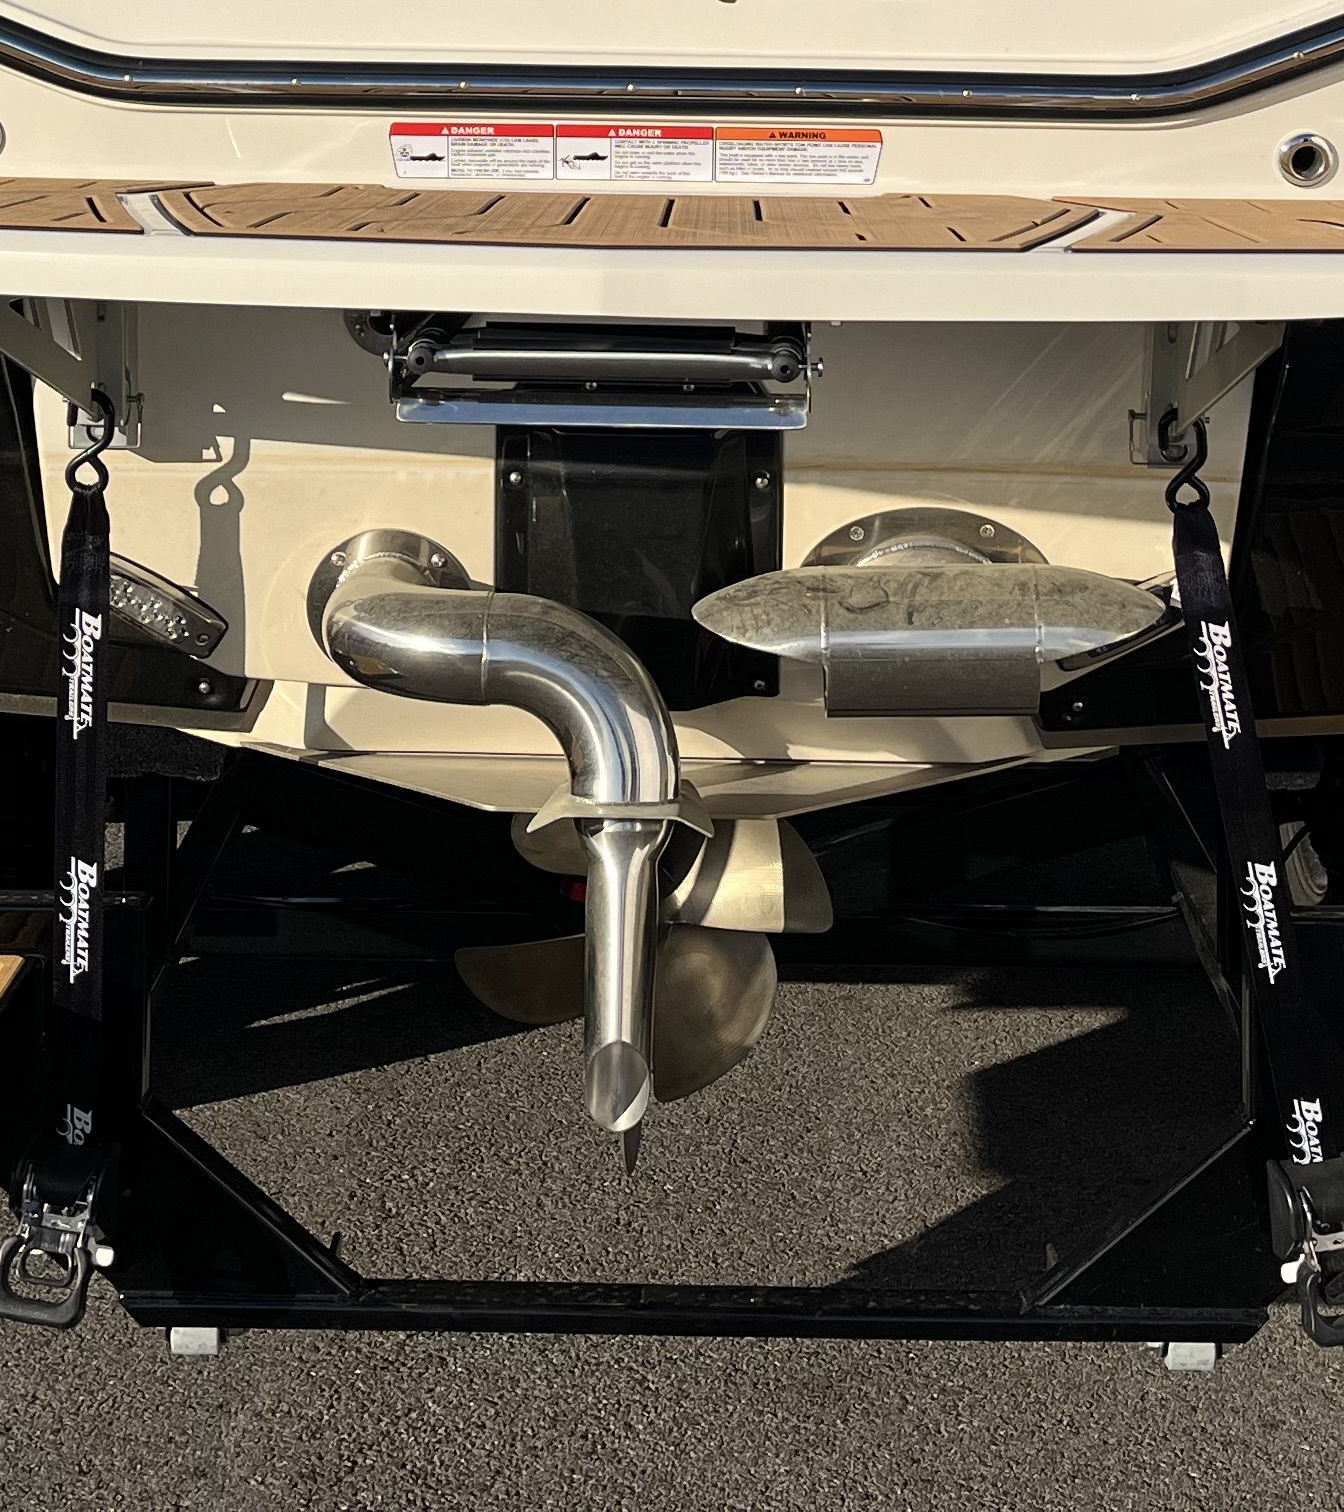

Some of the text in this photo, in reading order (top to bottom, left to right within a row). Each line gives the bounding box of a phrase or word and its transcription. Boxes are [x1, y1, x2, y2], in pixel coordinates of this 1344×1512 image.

[450, 126, 495, 135] DANGER
[618, 128, 662, 137] DANGER
[778, 131, 826, 140] WARNING
[81, 610, 102, 727] BOATMATE
[1208, 621, 1242, 734] BOATMATE
[77, 859, 97, 972] BOATMATE
[1254, 861, 1287, 969] BOATMATE
